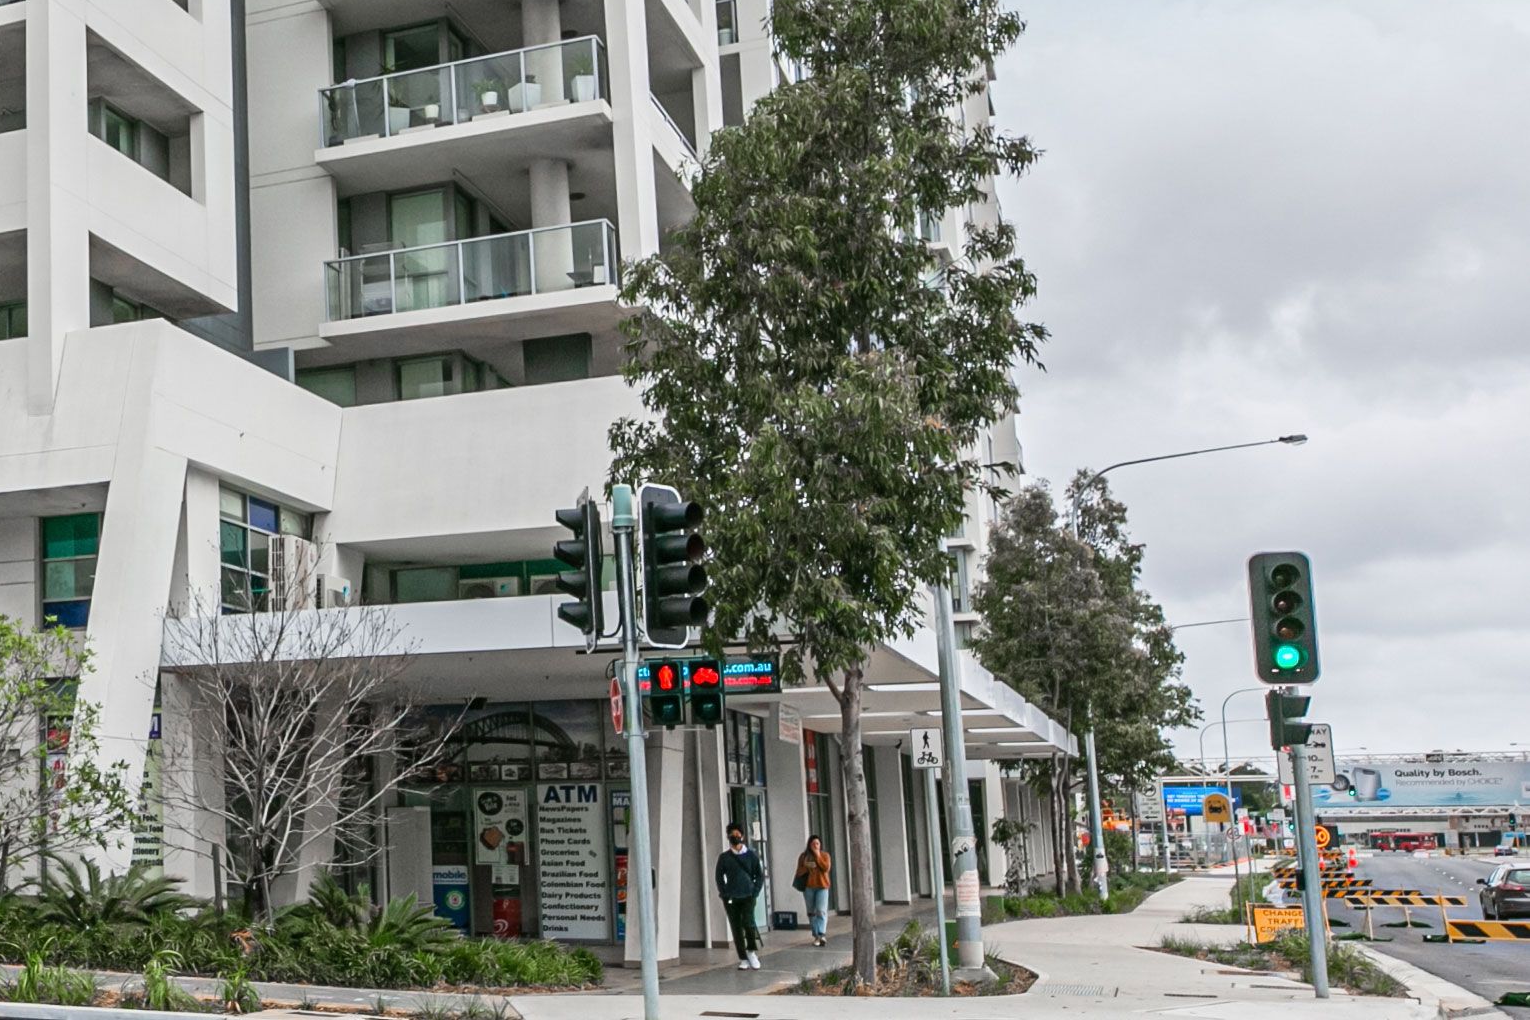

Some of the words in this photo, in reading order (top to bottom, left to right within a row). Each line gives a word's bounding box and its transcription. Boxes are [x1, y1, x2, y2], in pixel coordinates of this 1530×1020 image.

[1395, 769, 1430, 778] Quality
[1433, 769, 1445, 778] by
[543, 785, 597, 803] ATM
[539, 805, 589, 813] NewsPapers
[539, 816, 582, 824] Magazines
[433, 870, 467, 879] mobile
[541, 892, 563, 900] Dairy
